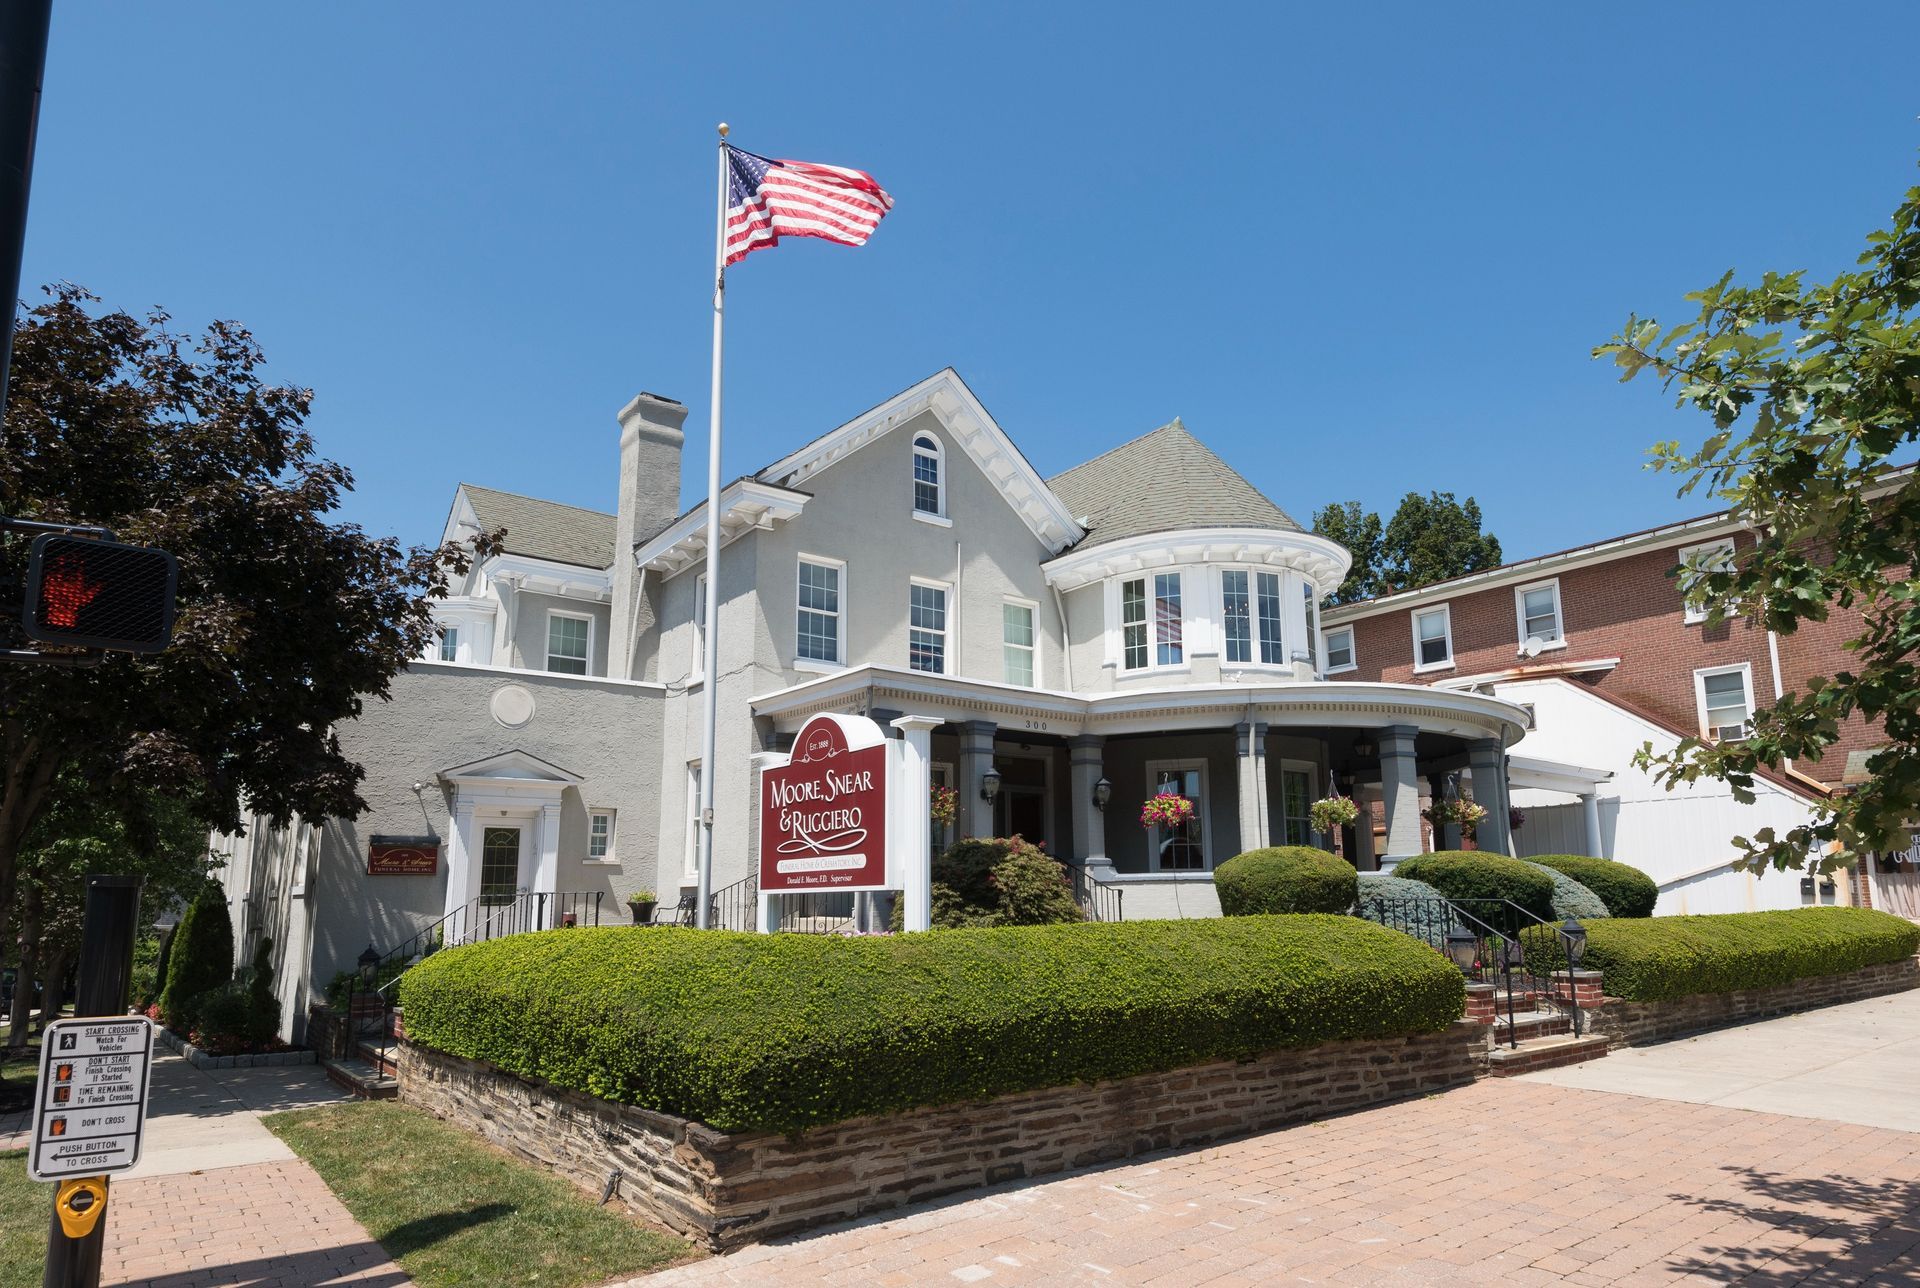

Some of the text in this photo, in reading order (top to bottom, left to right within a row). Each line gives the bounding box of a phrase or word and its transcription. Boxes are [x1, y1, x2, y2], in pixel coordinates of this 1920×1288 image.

[1025, 720, 1047, 731] 300
[825, 769, 874, 802] SNEAR
[792, 807, 862, 839] RUGGIERO
[831, 873, 853, 884] Supervisor
[85, 1025, 140, 1036] START CROSSING
[96, 1035, 127, 1044] Watch For
[99, 1043, 123, 1052] Vehicles
[89, 1055, 130, 1065] DON'T START
[85, 1064, 132, 1075] Finish Crossing
[92, 1073, 122, 1082] If Started
[79, 1084, 134, 1095] TIME REMAINING
[77, 1093, 134, 1104] To Finish Crossing
[81, 1116, 126, 1127] DON'T CROSS
[59, 1140, 117, 1153] PUSH BUTTON
[66, 1155, 108, 1167] TO CROSS
